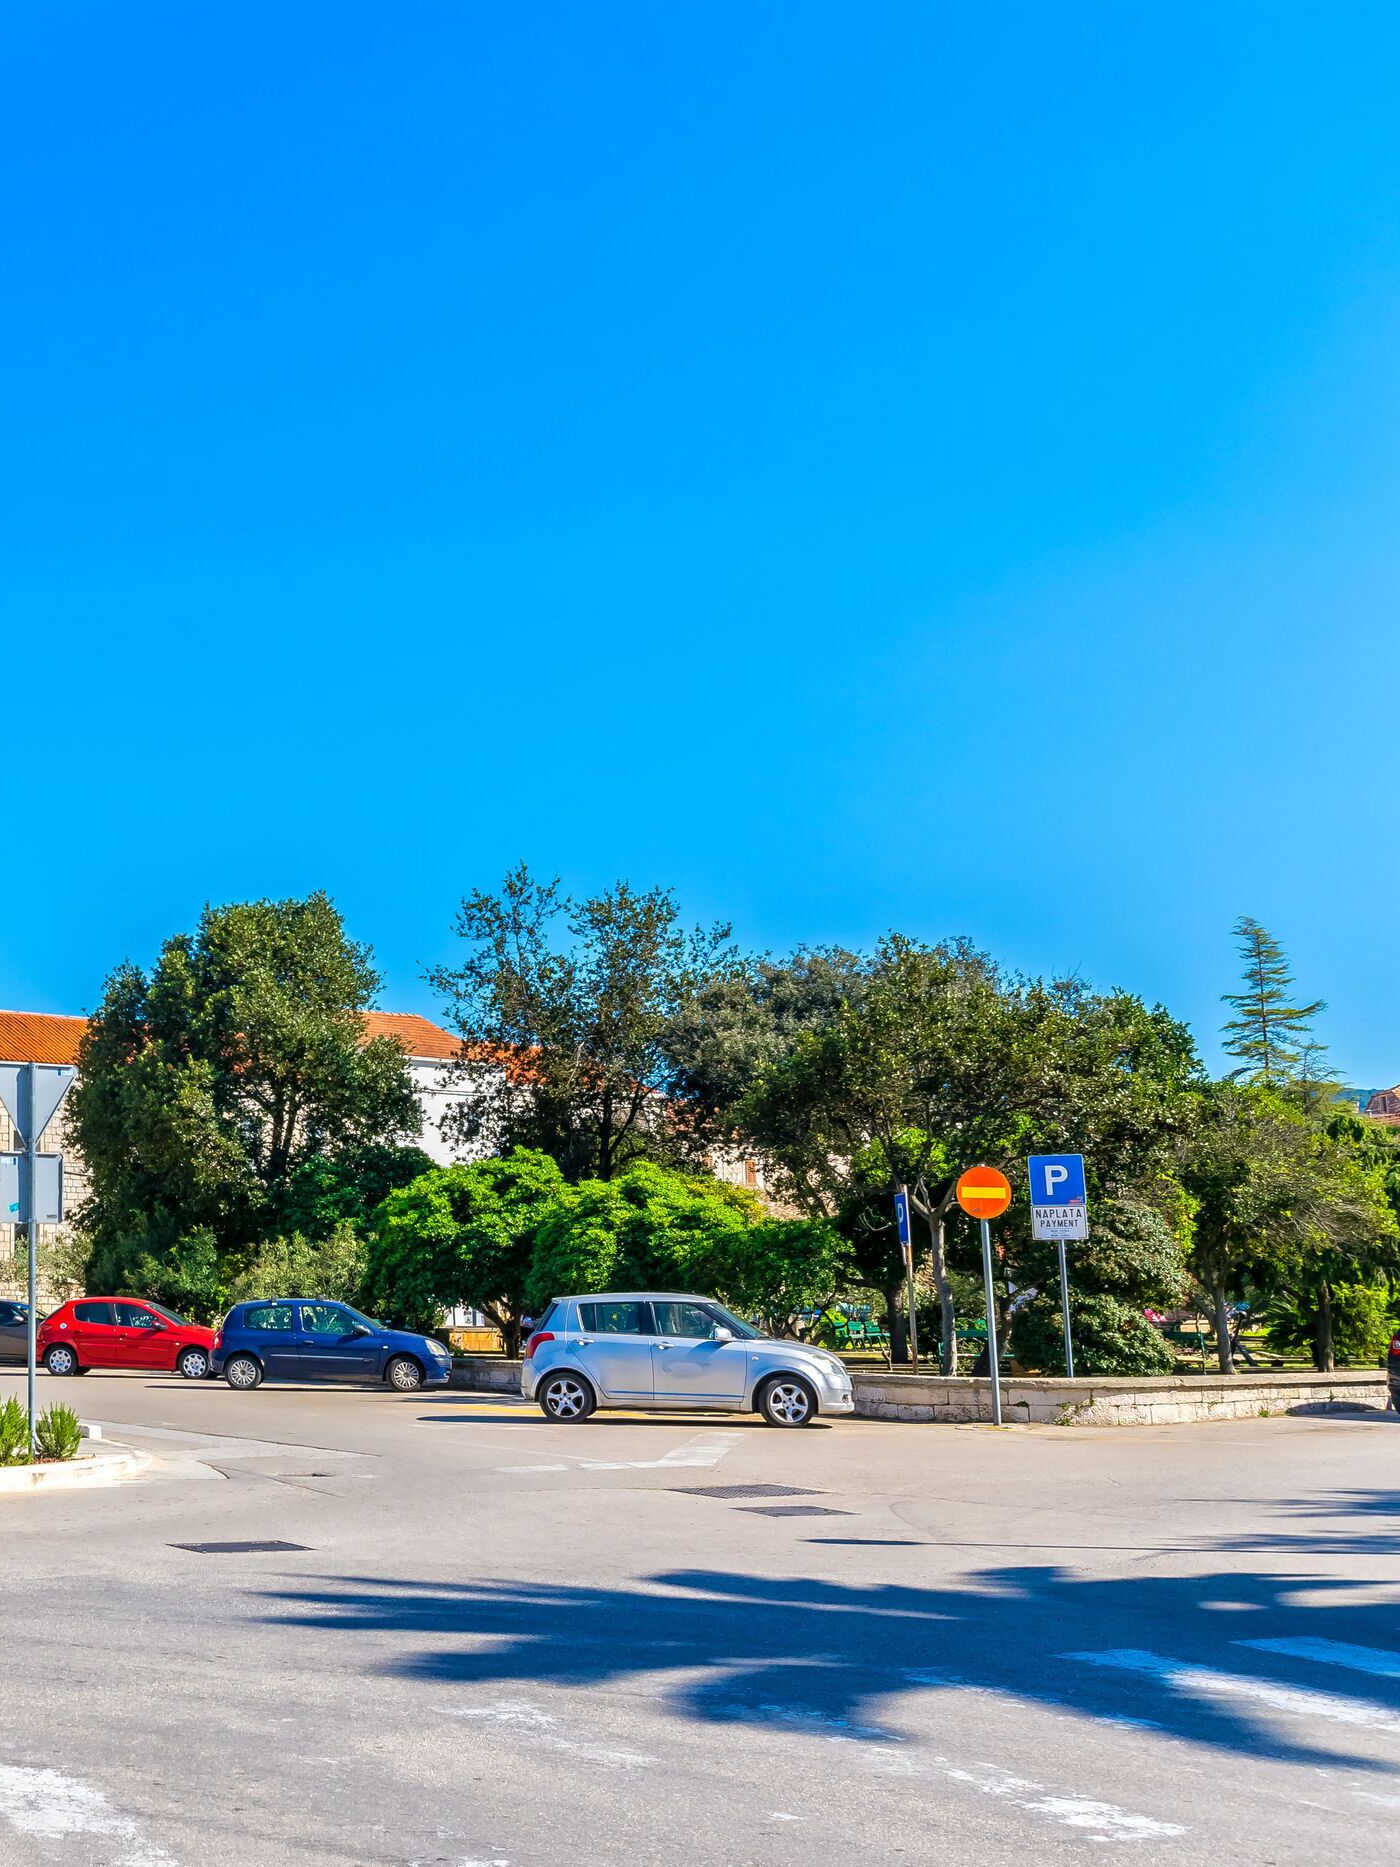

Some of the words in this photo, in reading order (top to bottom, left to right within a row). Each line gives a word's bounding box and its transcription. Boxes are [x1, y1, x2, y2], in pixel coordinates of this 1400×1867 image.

[1044, 1165, 1068, 1196] P
[1035, 1208, 1083, 1219] NAPLATA
[1040, 1219, 1079, 1228] PAYMENT
